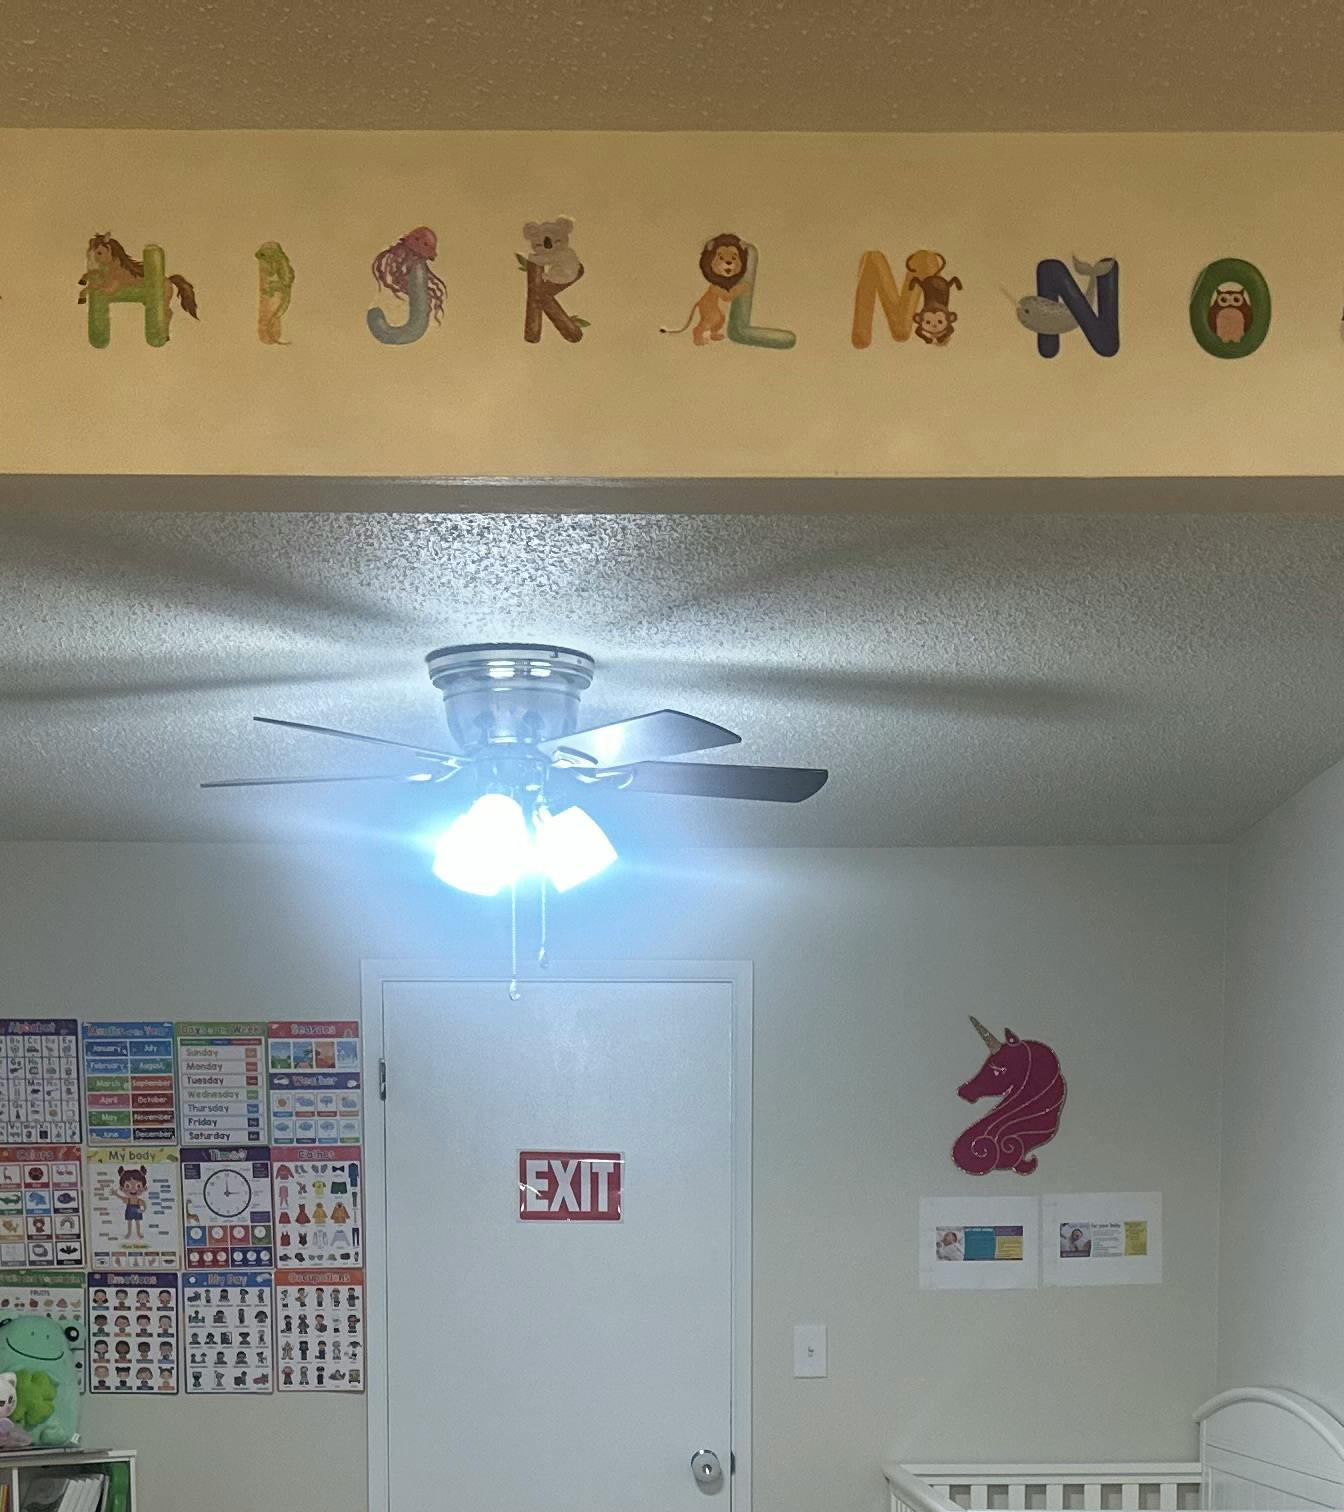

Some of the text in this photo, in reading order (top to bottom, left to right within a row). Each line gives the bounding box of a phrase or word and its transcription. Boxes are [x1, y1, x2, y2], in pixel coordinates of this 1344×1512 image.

[87, 243, 167, 349] H
[366, 254, 430, 346] J
[523, 257, 585, 344] K
[726, 243, 797, 350] L
[851, 249, 948, 350] M
[1036, 256, 1121, 360] N
[1189, 257, 1273, 360] O
[186, 1048, 218, 1059] Sunday
[186, 1062, 223, 1072] Monday
[187, 1076, 224, 1086] Tuesday
[188, 1089, 240, 1099] Wednesday
[137, 1096, 167, 1104] October
[188, 1103, 229, 1113] Thursday
[135, 1113, 172, 1121] November
[188, 1117, 218, 1127] Friday
[135, 1130, 173, 1140] December
[189, 1131, 230, 1141] Saturday
[109, 1150, 156, 1162] My body
[526, 1159, 614, 1213] EXIT
[288, 1273, 351, 1284] Occupations
